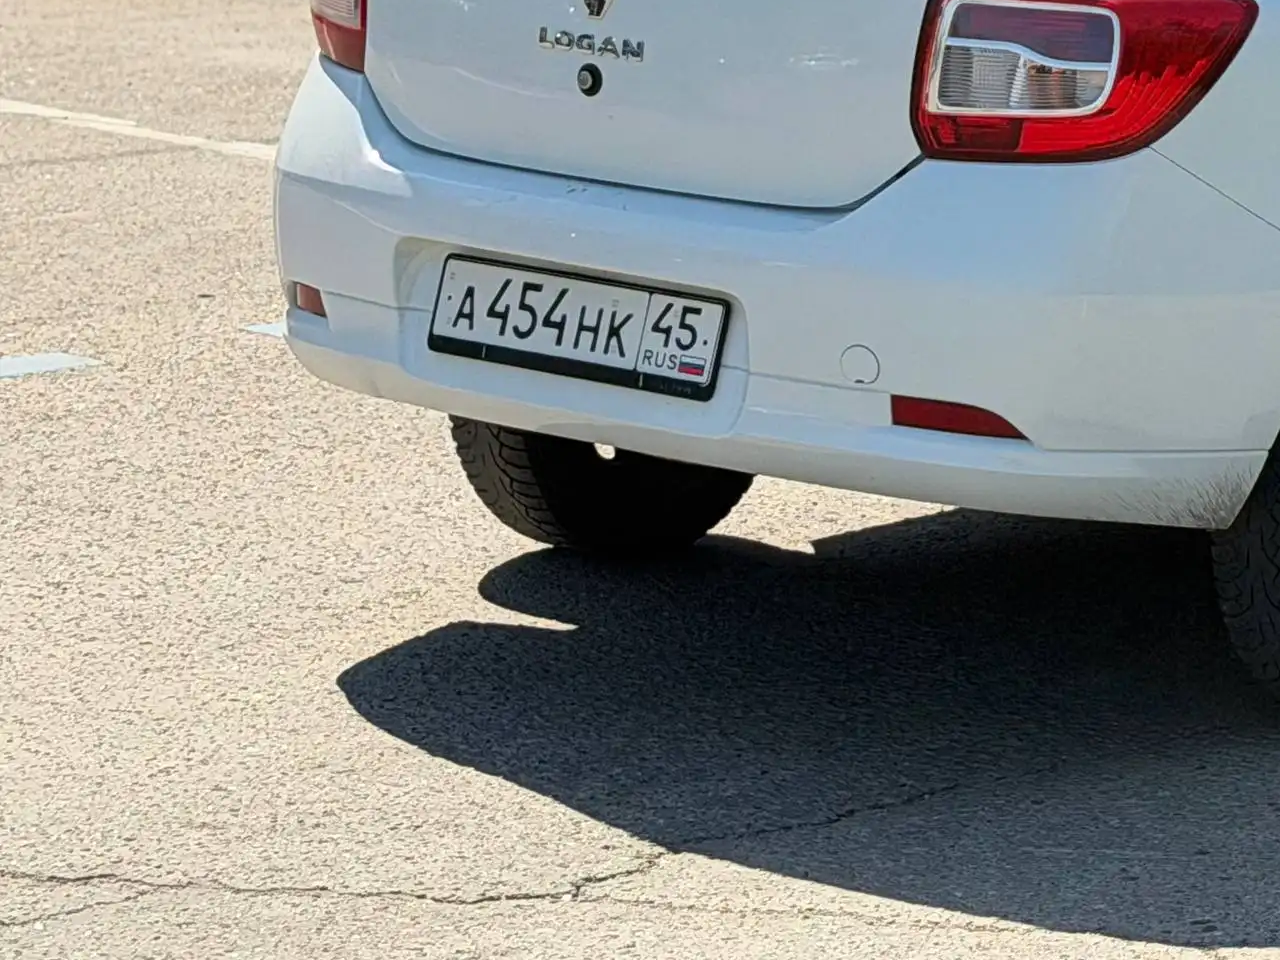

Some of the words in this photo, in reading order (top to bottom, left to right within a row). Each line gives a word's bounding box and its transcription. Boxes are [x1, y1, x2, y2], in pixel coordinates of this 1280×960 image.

[537, 26, 646, 62] LOGAN
[650, 302, 703, 351] 45
[641, 348, 678, 371] RUS
